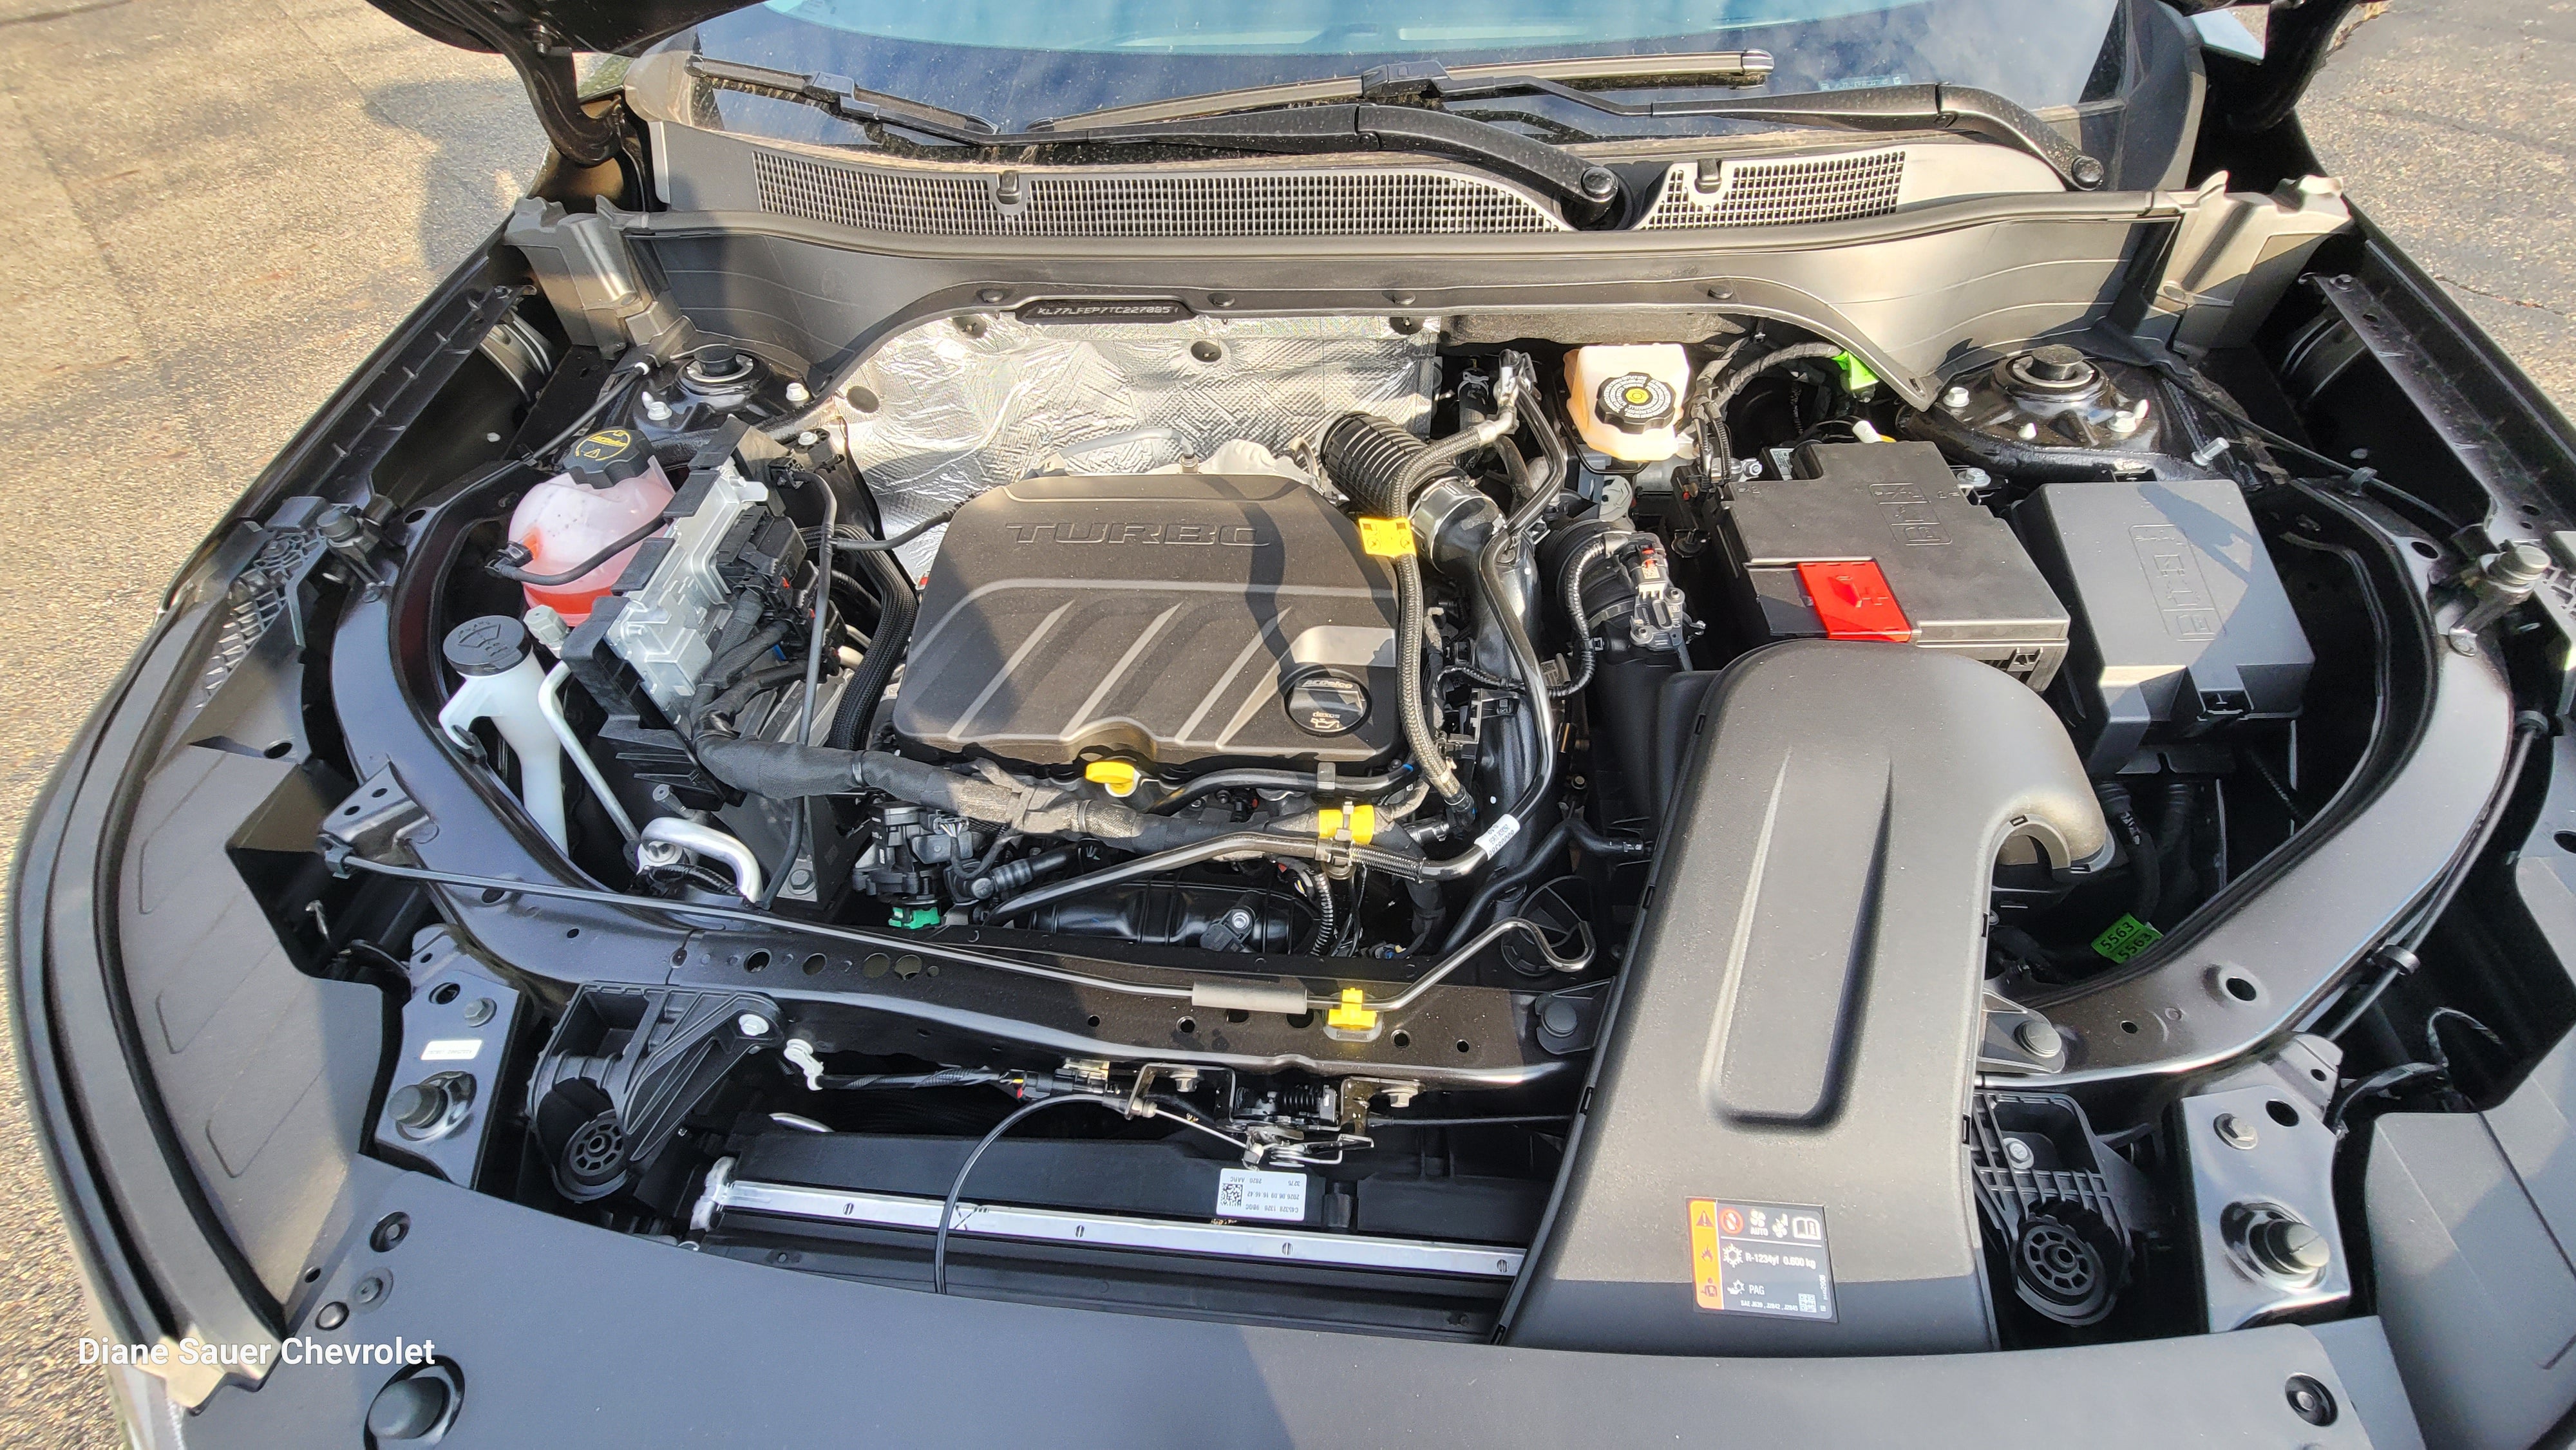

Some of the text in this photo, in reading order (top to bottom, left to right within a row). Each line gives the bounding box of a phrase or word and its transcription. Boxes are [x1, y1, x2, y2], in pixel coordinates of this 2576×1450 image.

[1005, 522, 1271, 547] TURBO
[1302, 679, 1353, 689] ACDelco
[2099, 921, 2135, 950] 5563
[2117, 932, 2152, 960] 5563
[1750, 1227, 1768, 1236] AUTO
[1806, 1259, 1817, 1270] kg
[1748, 1284, 1765, 1295] PAG
